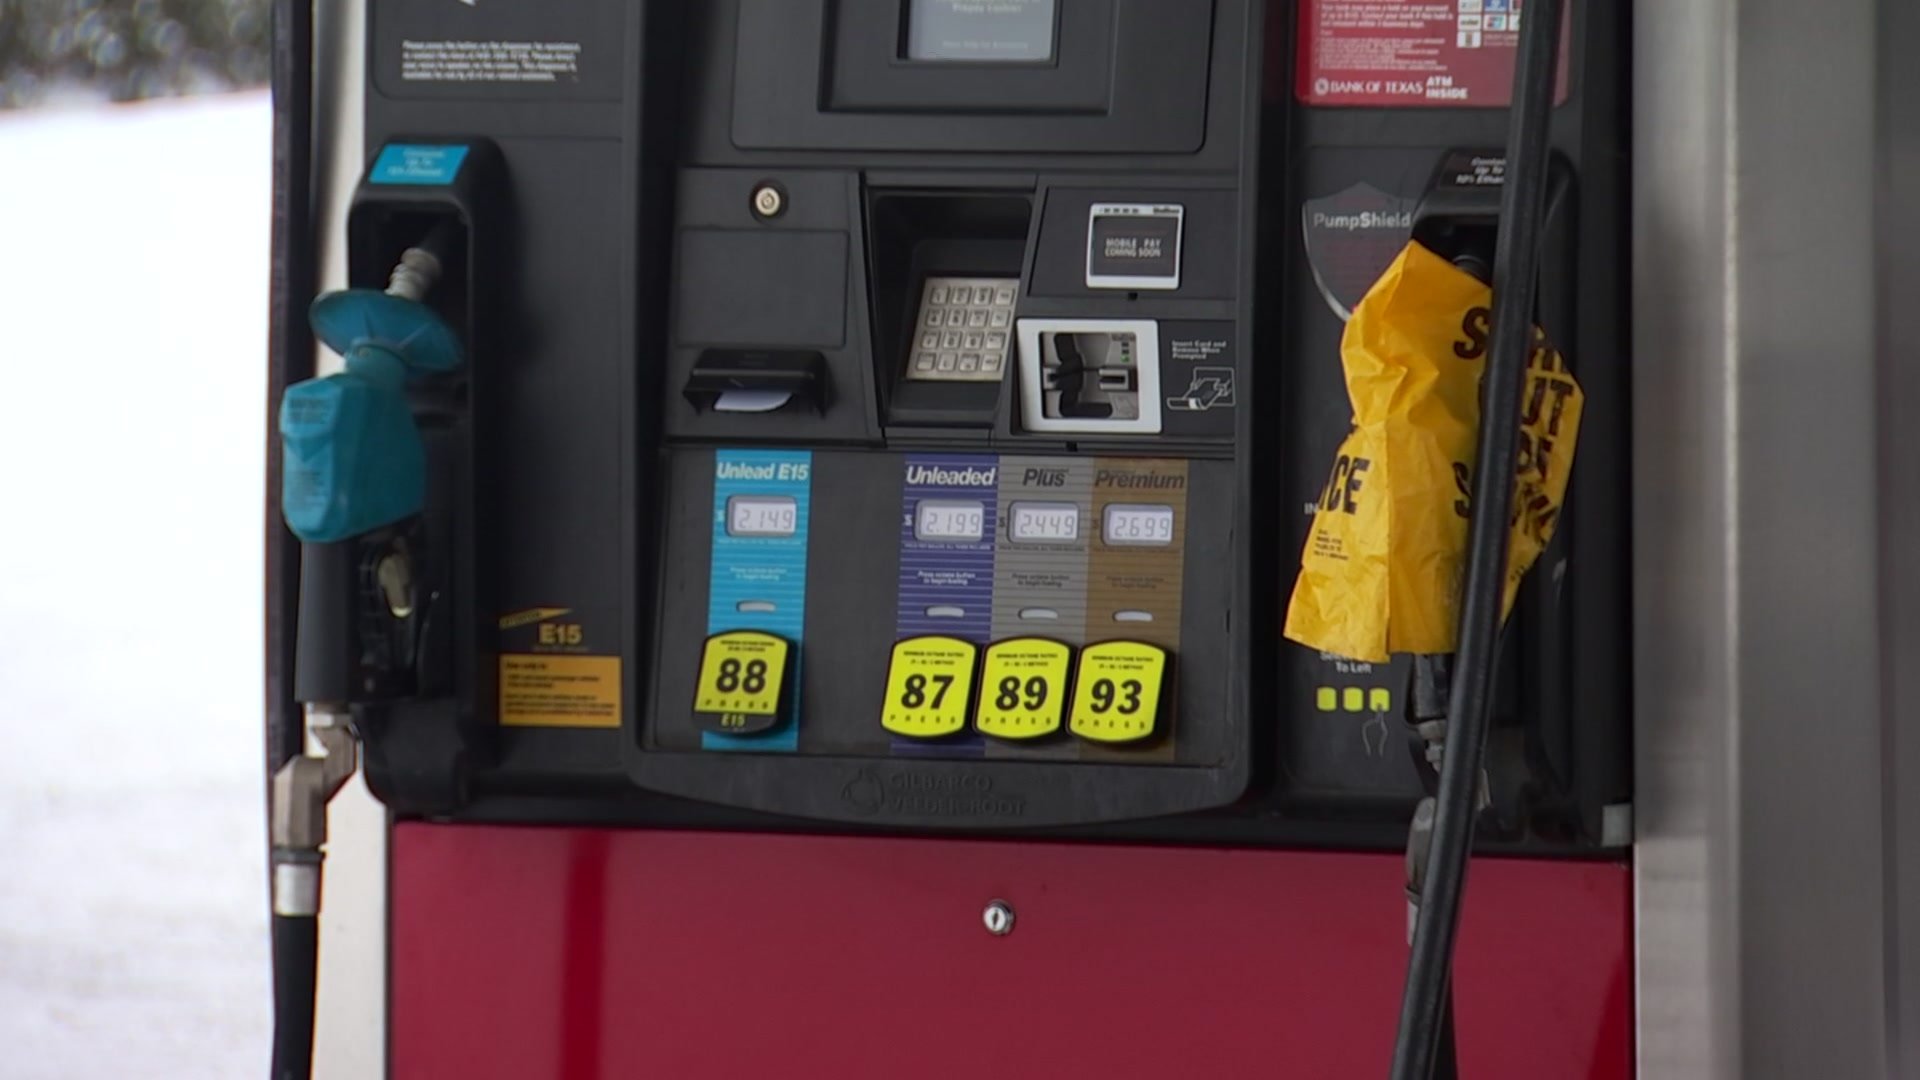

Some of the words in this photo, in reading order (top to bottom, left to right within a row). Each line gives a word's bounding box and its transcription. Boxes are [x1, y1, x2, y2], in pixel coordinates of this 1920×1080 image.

[1330, 80, 1364, 93] BANK
[1365, 80, 1380, 93] OF
[1386, 81, 1423, 94] TEXAS
[1426, 76, 1453, 86] ATM
[1426, 88, 1468, 99] INSIDE
[1313, 211, 1412, 231] PumpShield
[1106, 238, 1137, 249] MOBILE
[1144, 239, 1162, 249] PAY
[717, 462, 775, 480] Unlead
[777, 463, 809, 482] E15
[905, 466, 996, 486] Unleaded
[1022, 468, 1066, 488] Plus
[1094, 470, 1185, 490] Premium
[1020, 513, 1077, 535] 2.449
[1114, 516, 1171, 538] 2.699
[540, 623, 584, 645] E15
[716, 657, 768, 695] 88
[1336, 661, 1349, 673] To
[1350, 662, 1372, 674] Left
[901, 673, 955, 710] 87
[995, 675, 1049, 712] 89
[1090, 678, 1143, 715] 93
